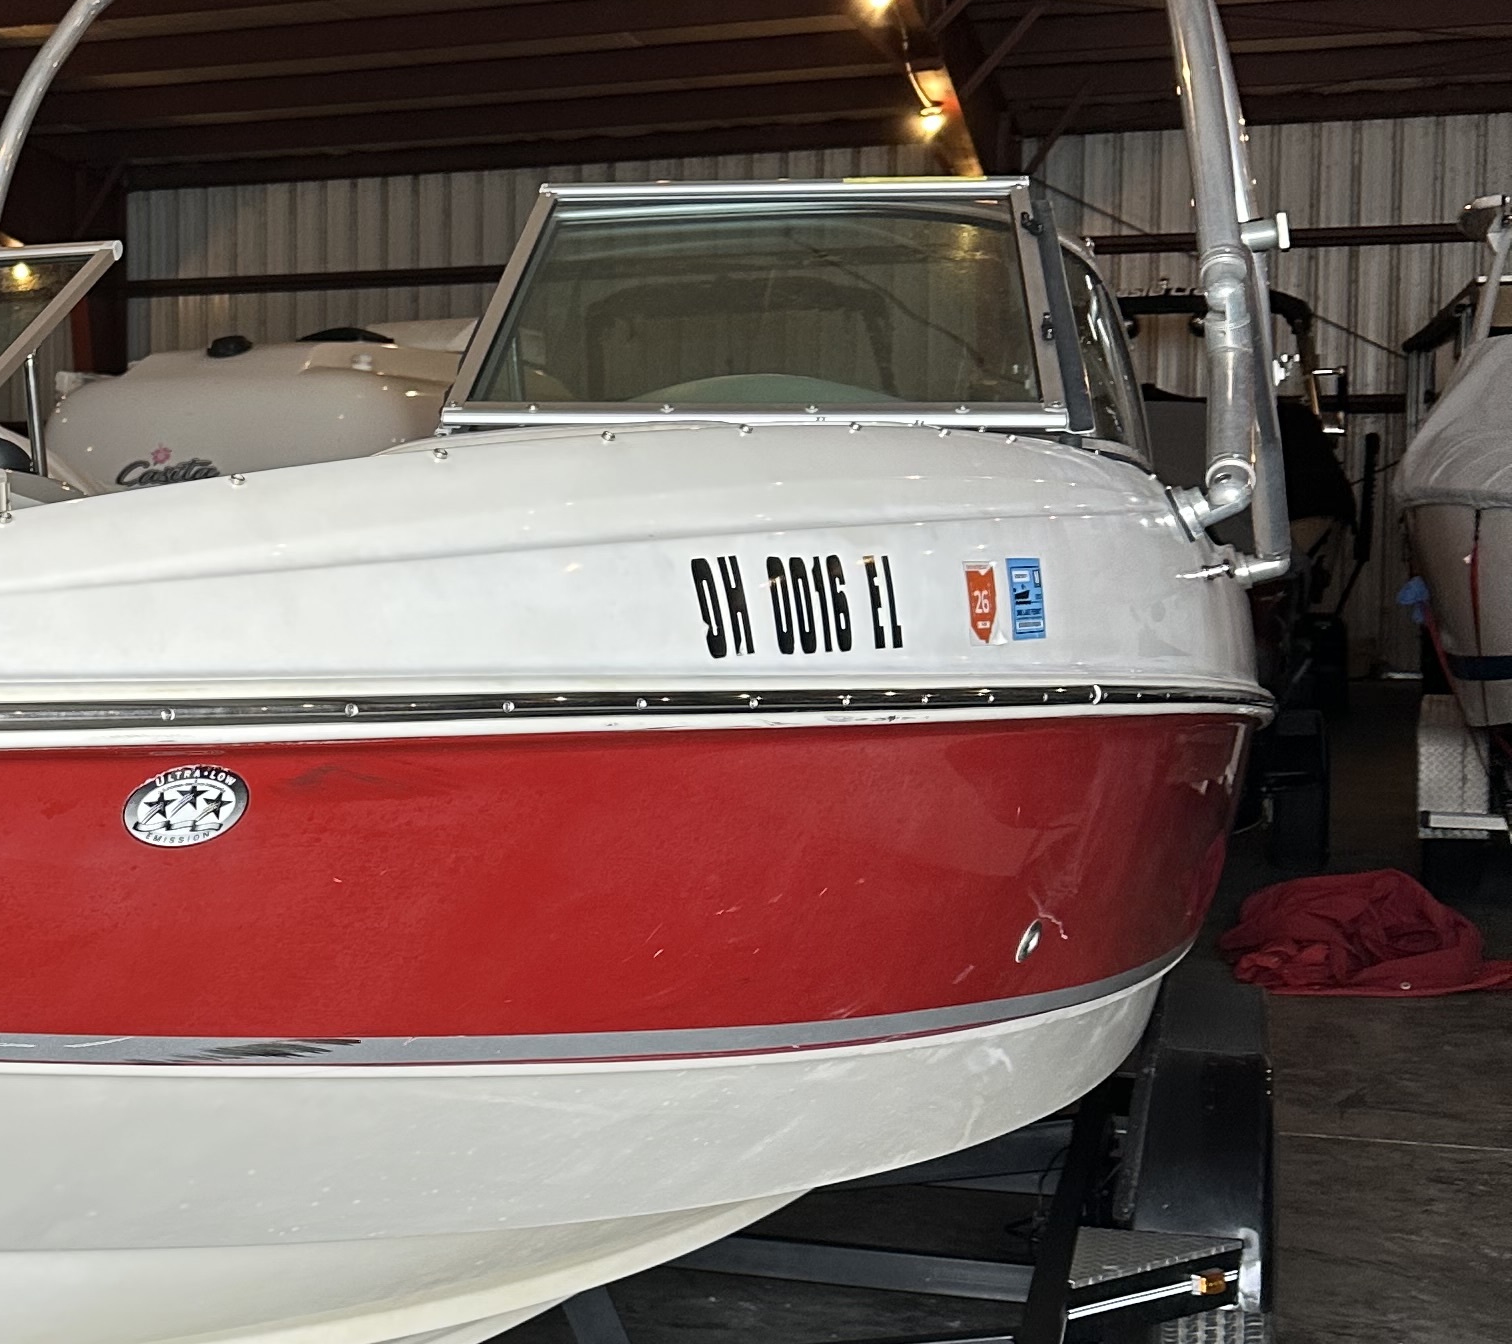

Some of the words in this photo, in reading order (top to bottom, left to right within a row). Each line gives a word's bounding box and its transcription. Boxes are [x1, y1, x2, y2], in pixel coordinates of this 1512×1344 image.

[116, 458, 220, 486] Casita
[691, 556, 755, 658] OH
[766, 555, 852, 655] 0016
[973, 590, 990, 614] 26
[145, 831, 210, 844] EMISSION
